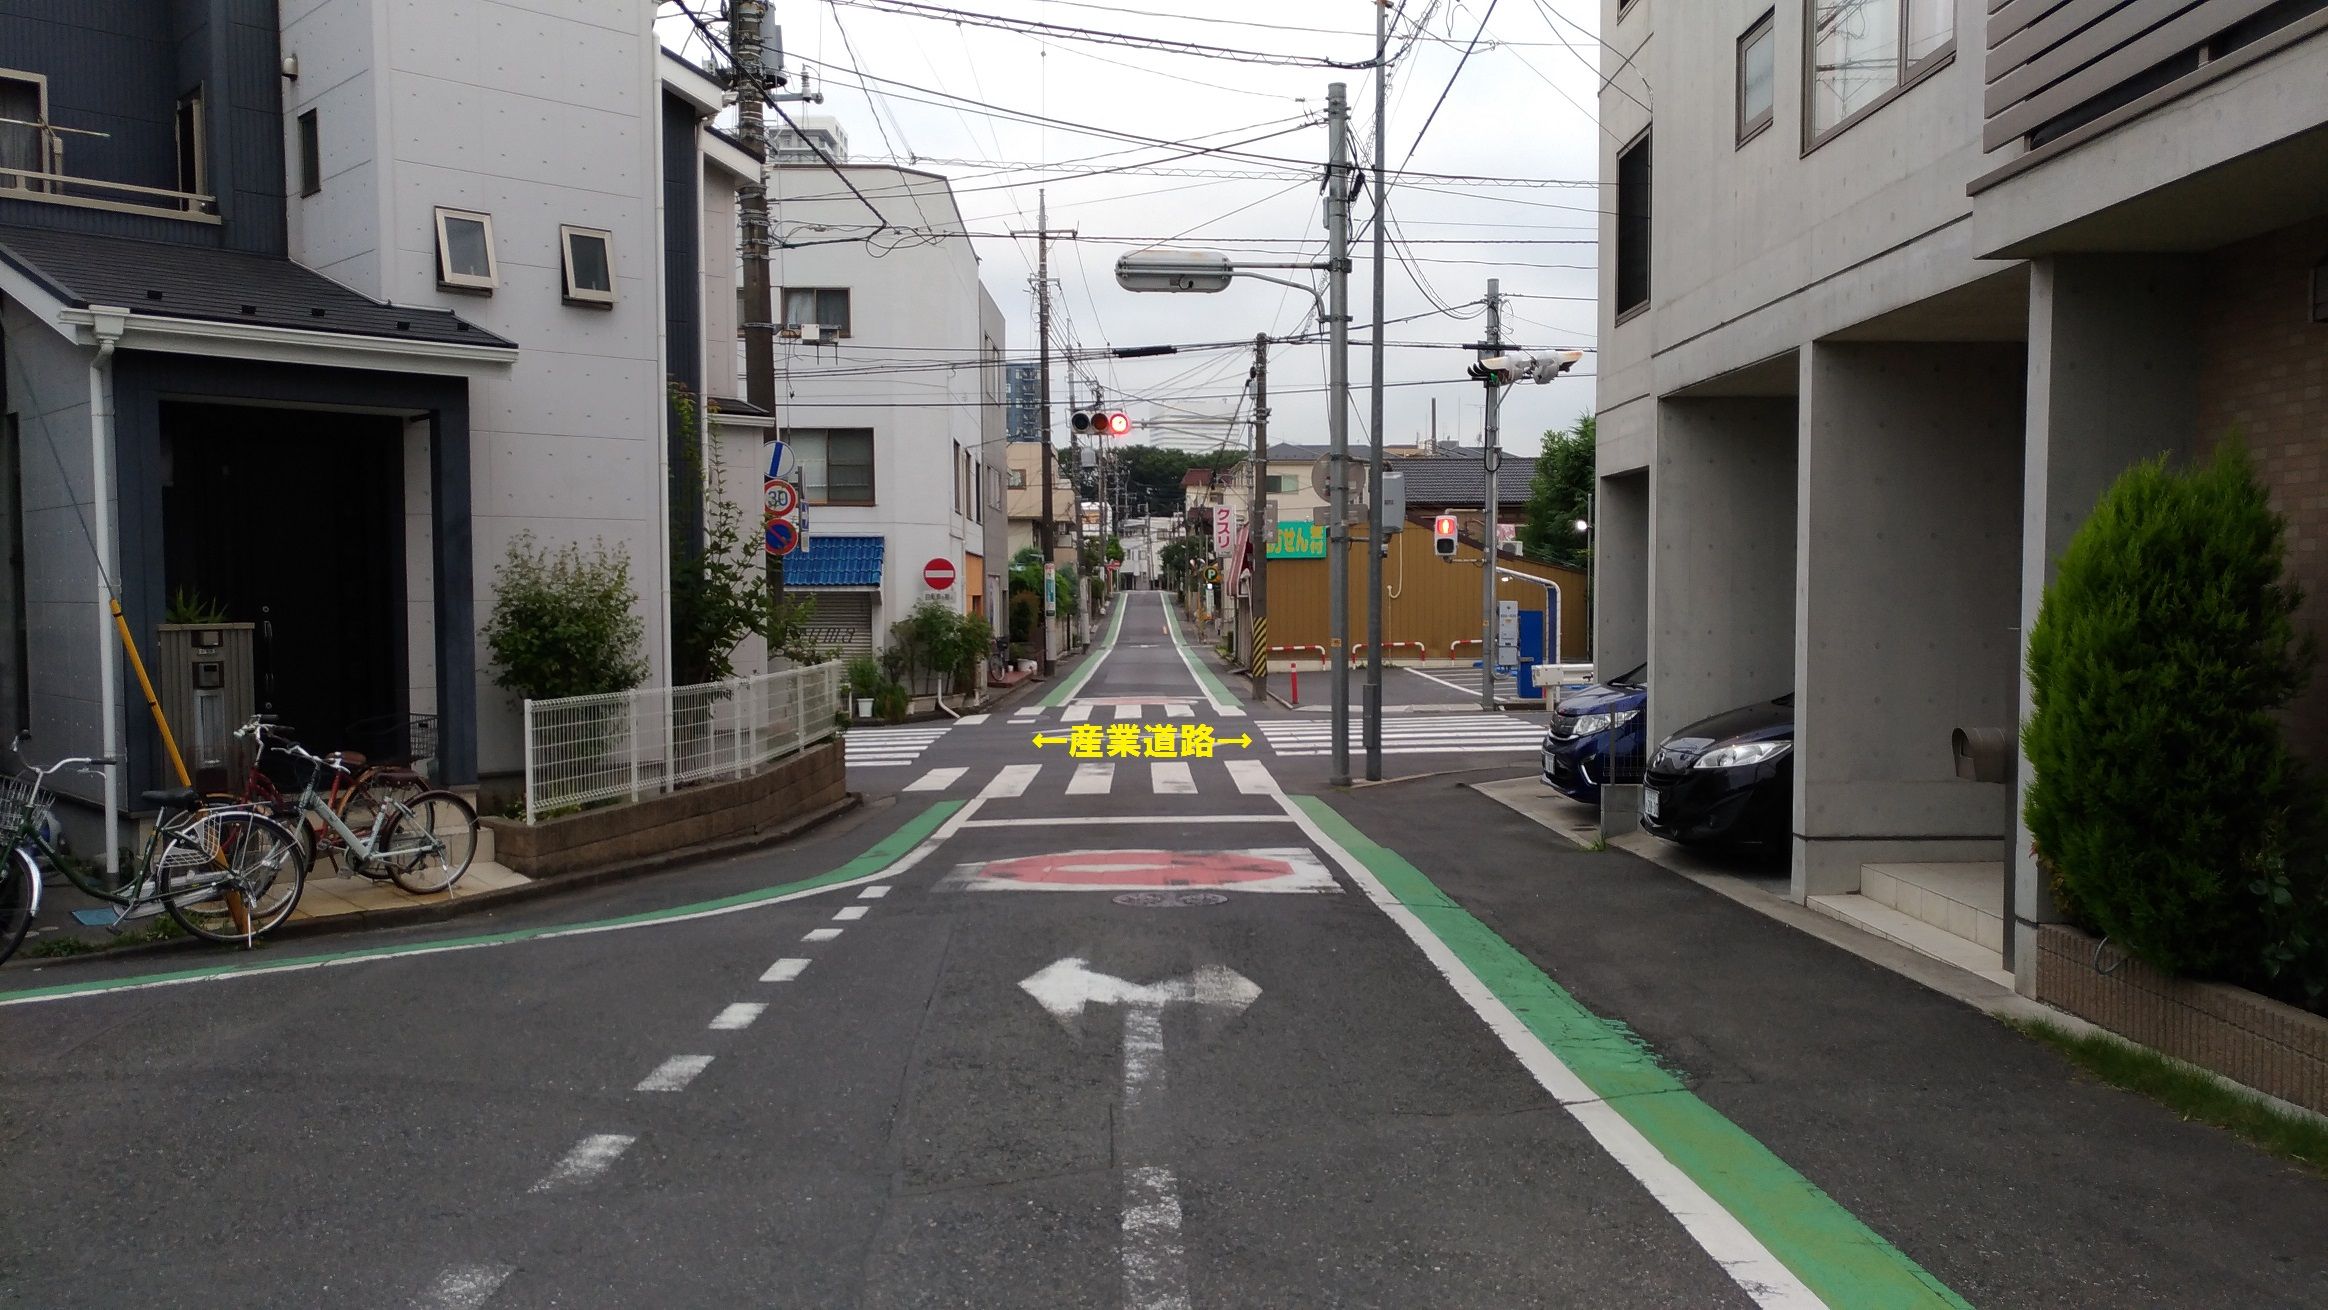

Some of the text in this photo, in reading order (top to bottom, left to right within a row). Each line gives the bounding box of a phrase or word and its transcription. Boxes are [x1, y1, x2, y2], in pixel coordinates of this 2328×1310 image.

[768, 490, 788, 507] 30
[1217, 508, 1231, 549] クスリ
[1207, 569, 1216, 580] P
